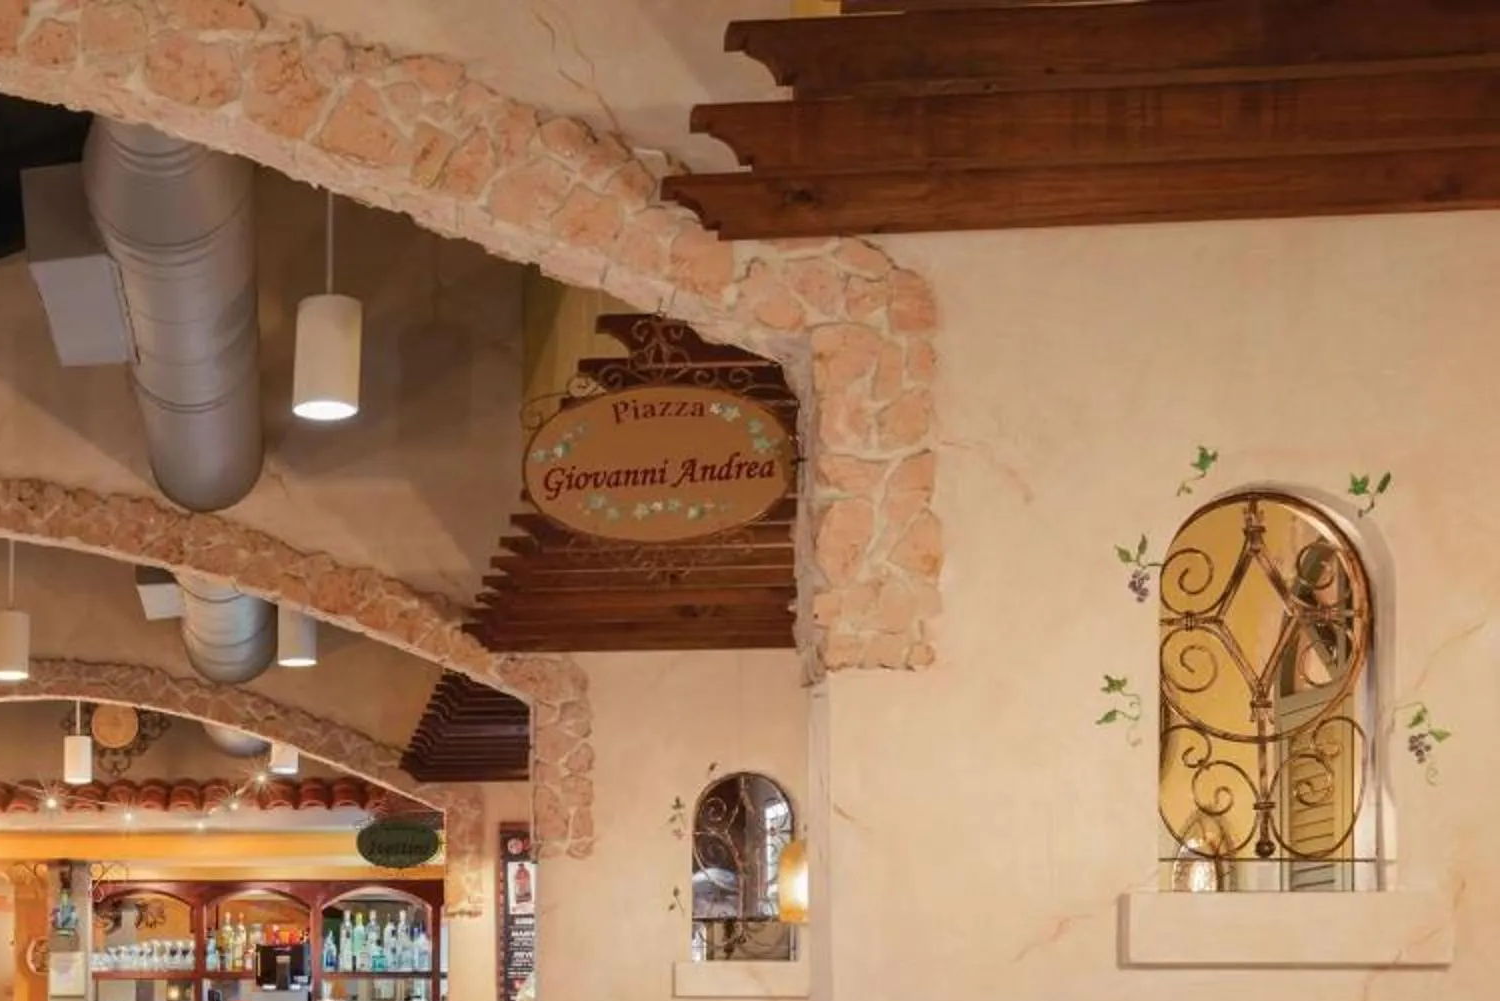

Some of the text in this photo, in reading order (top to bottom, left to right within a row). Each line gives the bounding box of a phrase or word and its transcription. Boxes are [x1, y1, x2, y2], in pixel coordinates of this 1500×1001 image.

[611, 400, 705, 425] Piazza
[543, 452, 776, 500] Giovanni Andrea
